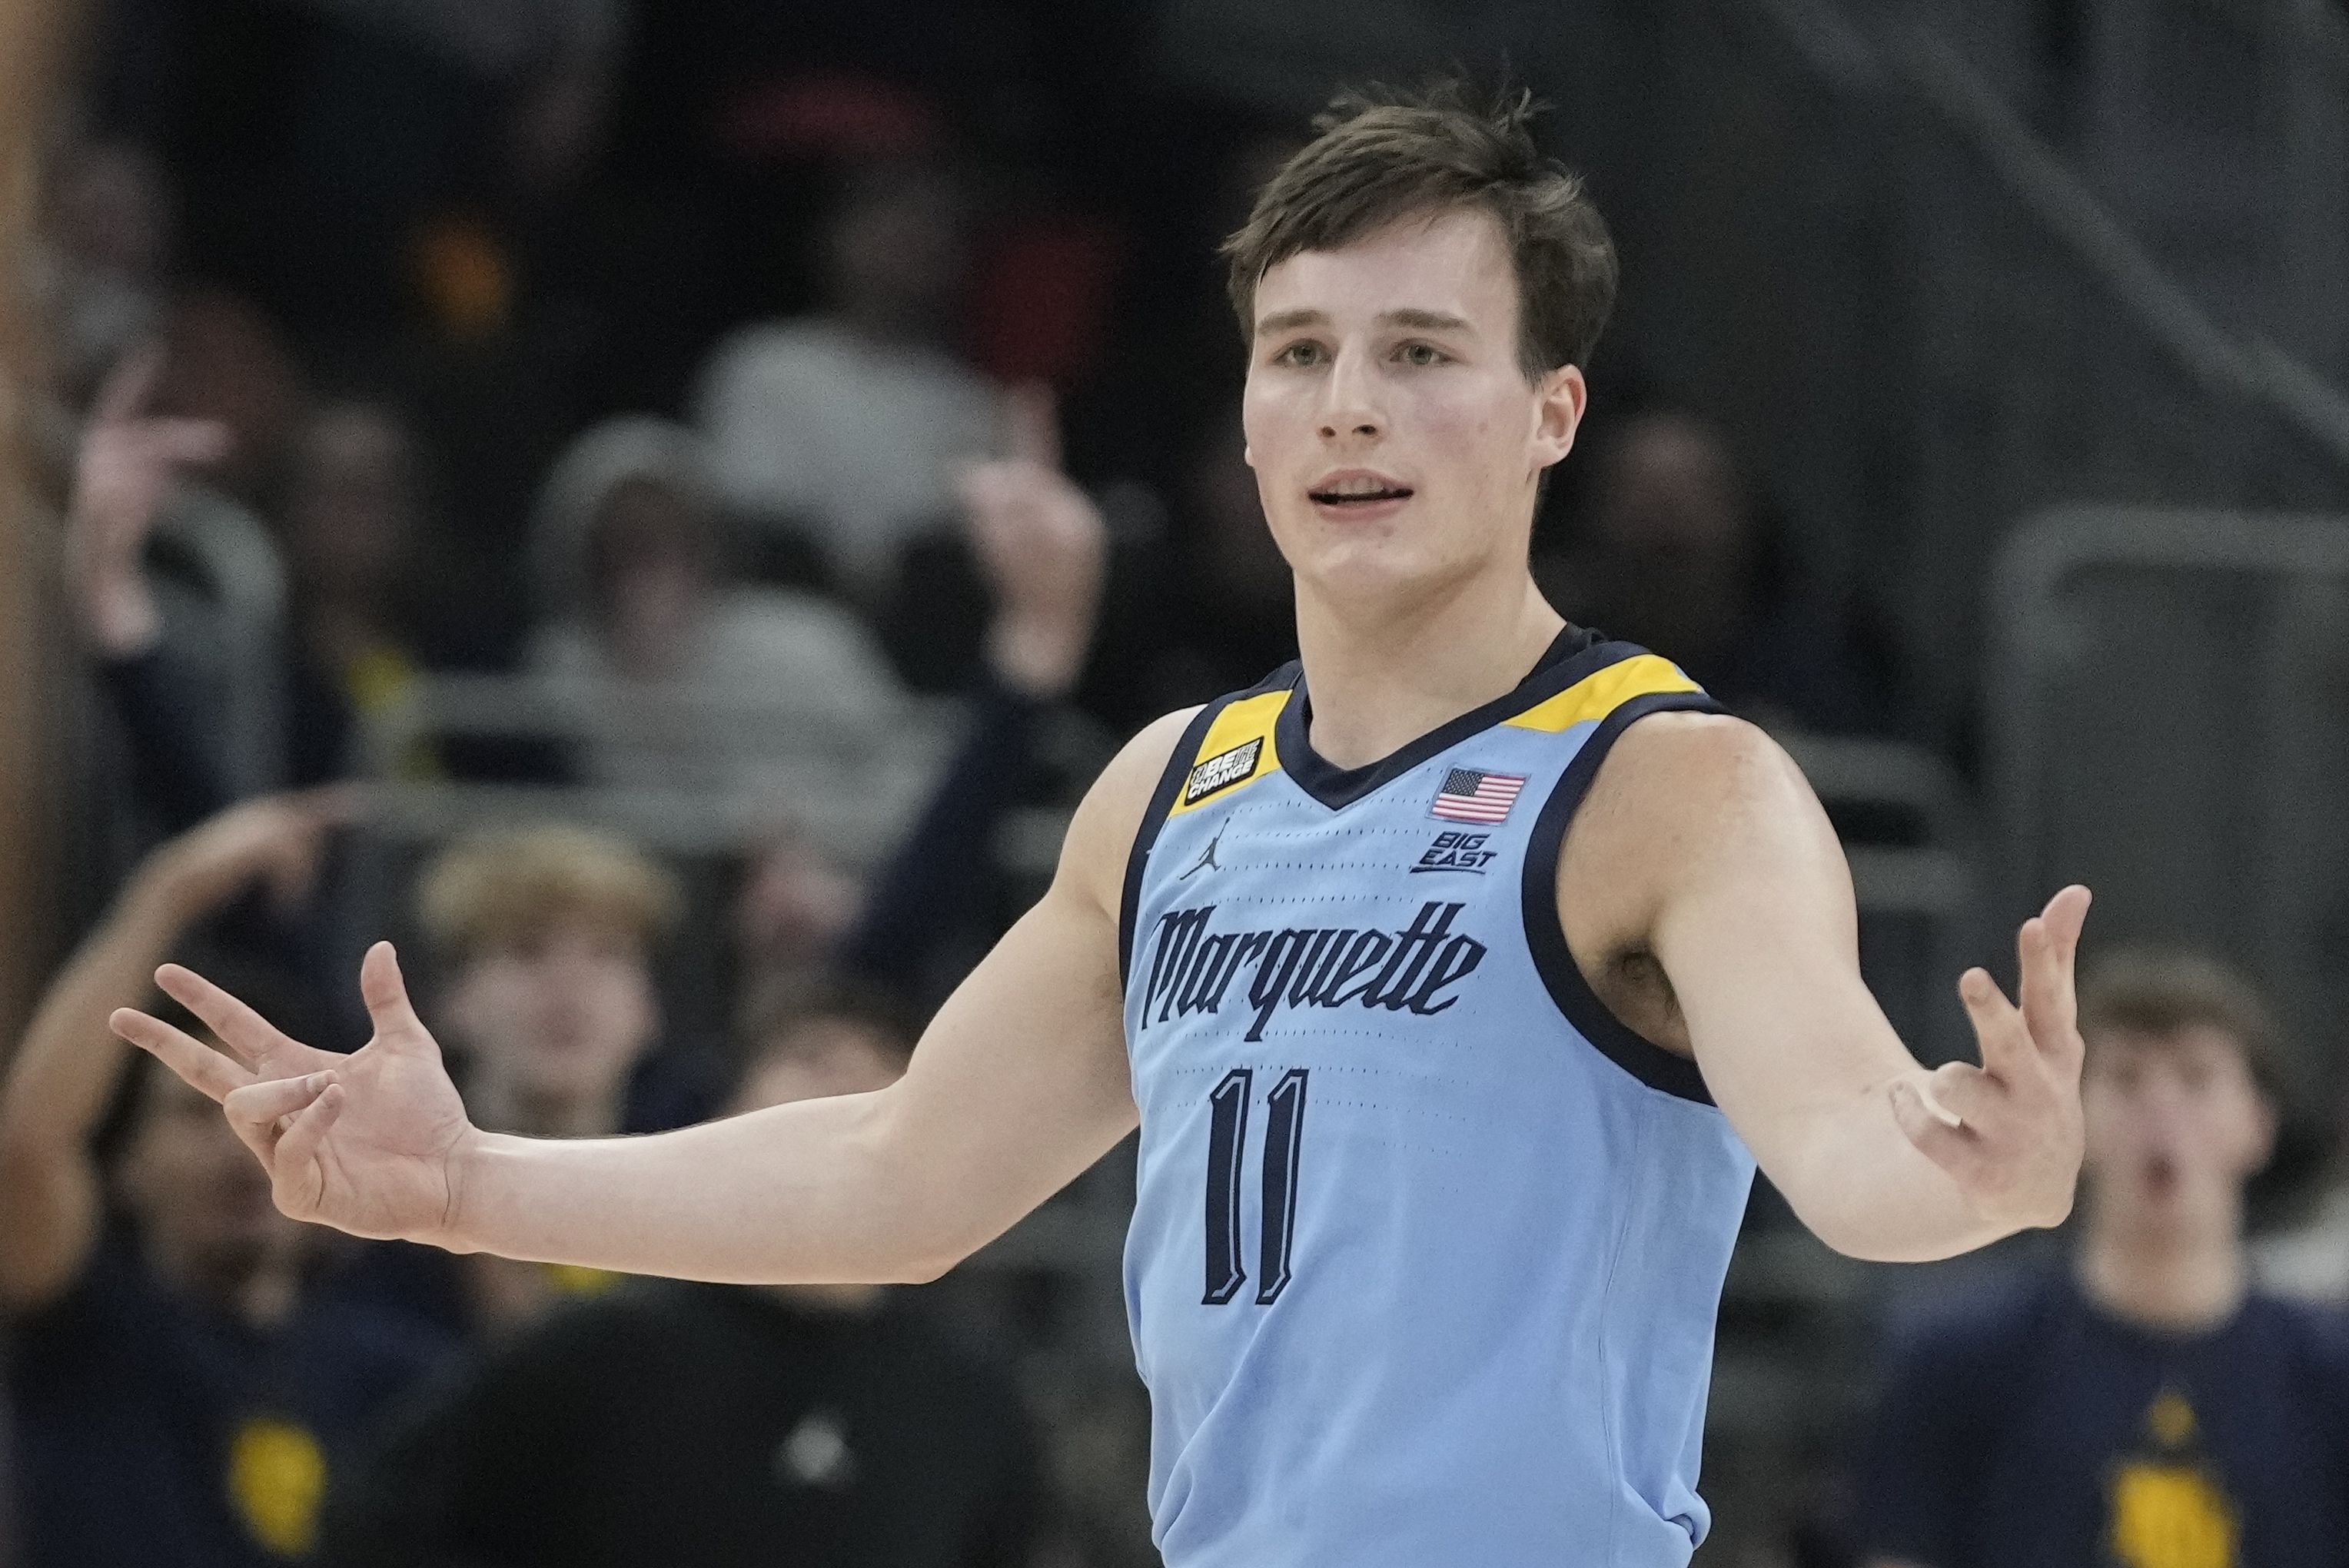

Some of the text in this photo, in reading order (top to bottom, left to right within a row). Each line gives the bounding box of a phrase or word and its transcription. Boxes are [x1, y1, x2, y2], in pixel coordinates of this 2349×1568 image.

[1187, 758, 1254, 799] CHANGE
[1203, 749, 1238, 779] BE
[1419, 848, 1499, 868] EAST
[1431, 831, 1492, 850] BIG
[1141, 901, 1488, 1042] Marquette
[1201, 1068, 1310, 1305] 11
